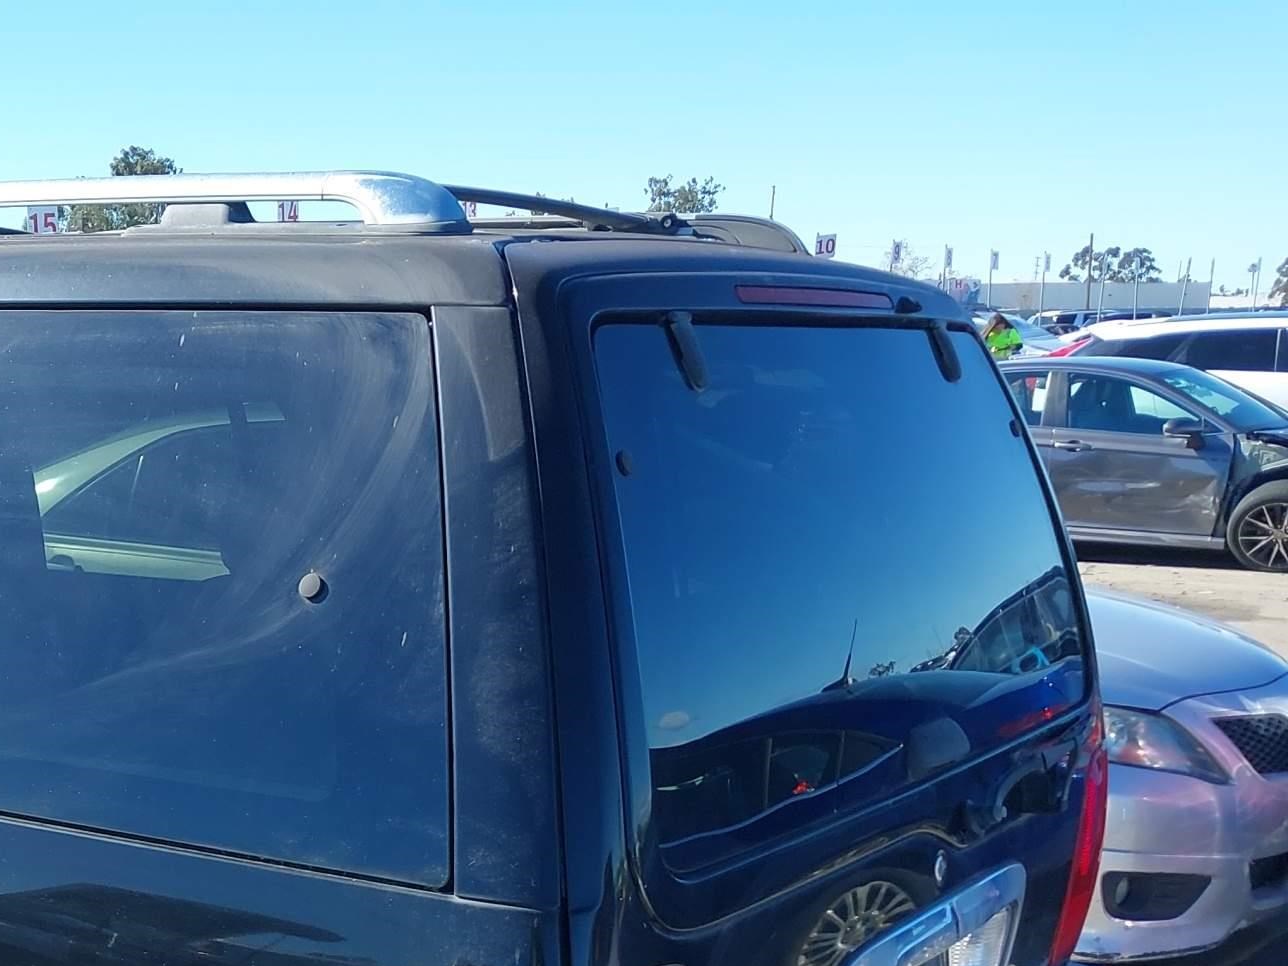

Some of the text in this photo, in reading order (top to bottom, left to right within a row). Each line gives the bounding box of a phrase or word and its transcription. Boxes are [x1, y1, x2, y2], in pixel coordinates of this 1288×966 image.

[278, 200, 298, 222] 14
[28, 212, 57, 233] 15
[815, 238, 836, 255] 10
[894, 243, 900, 260] 9
